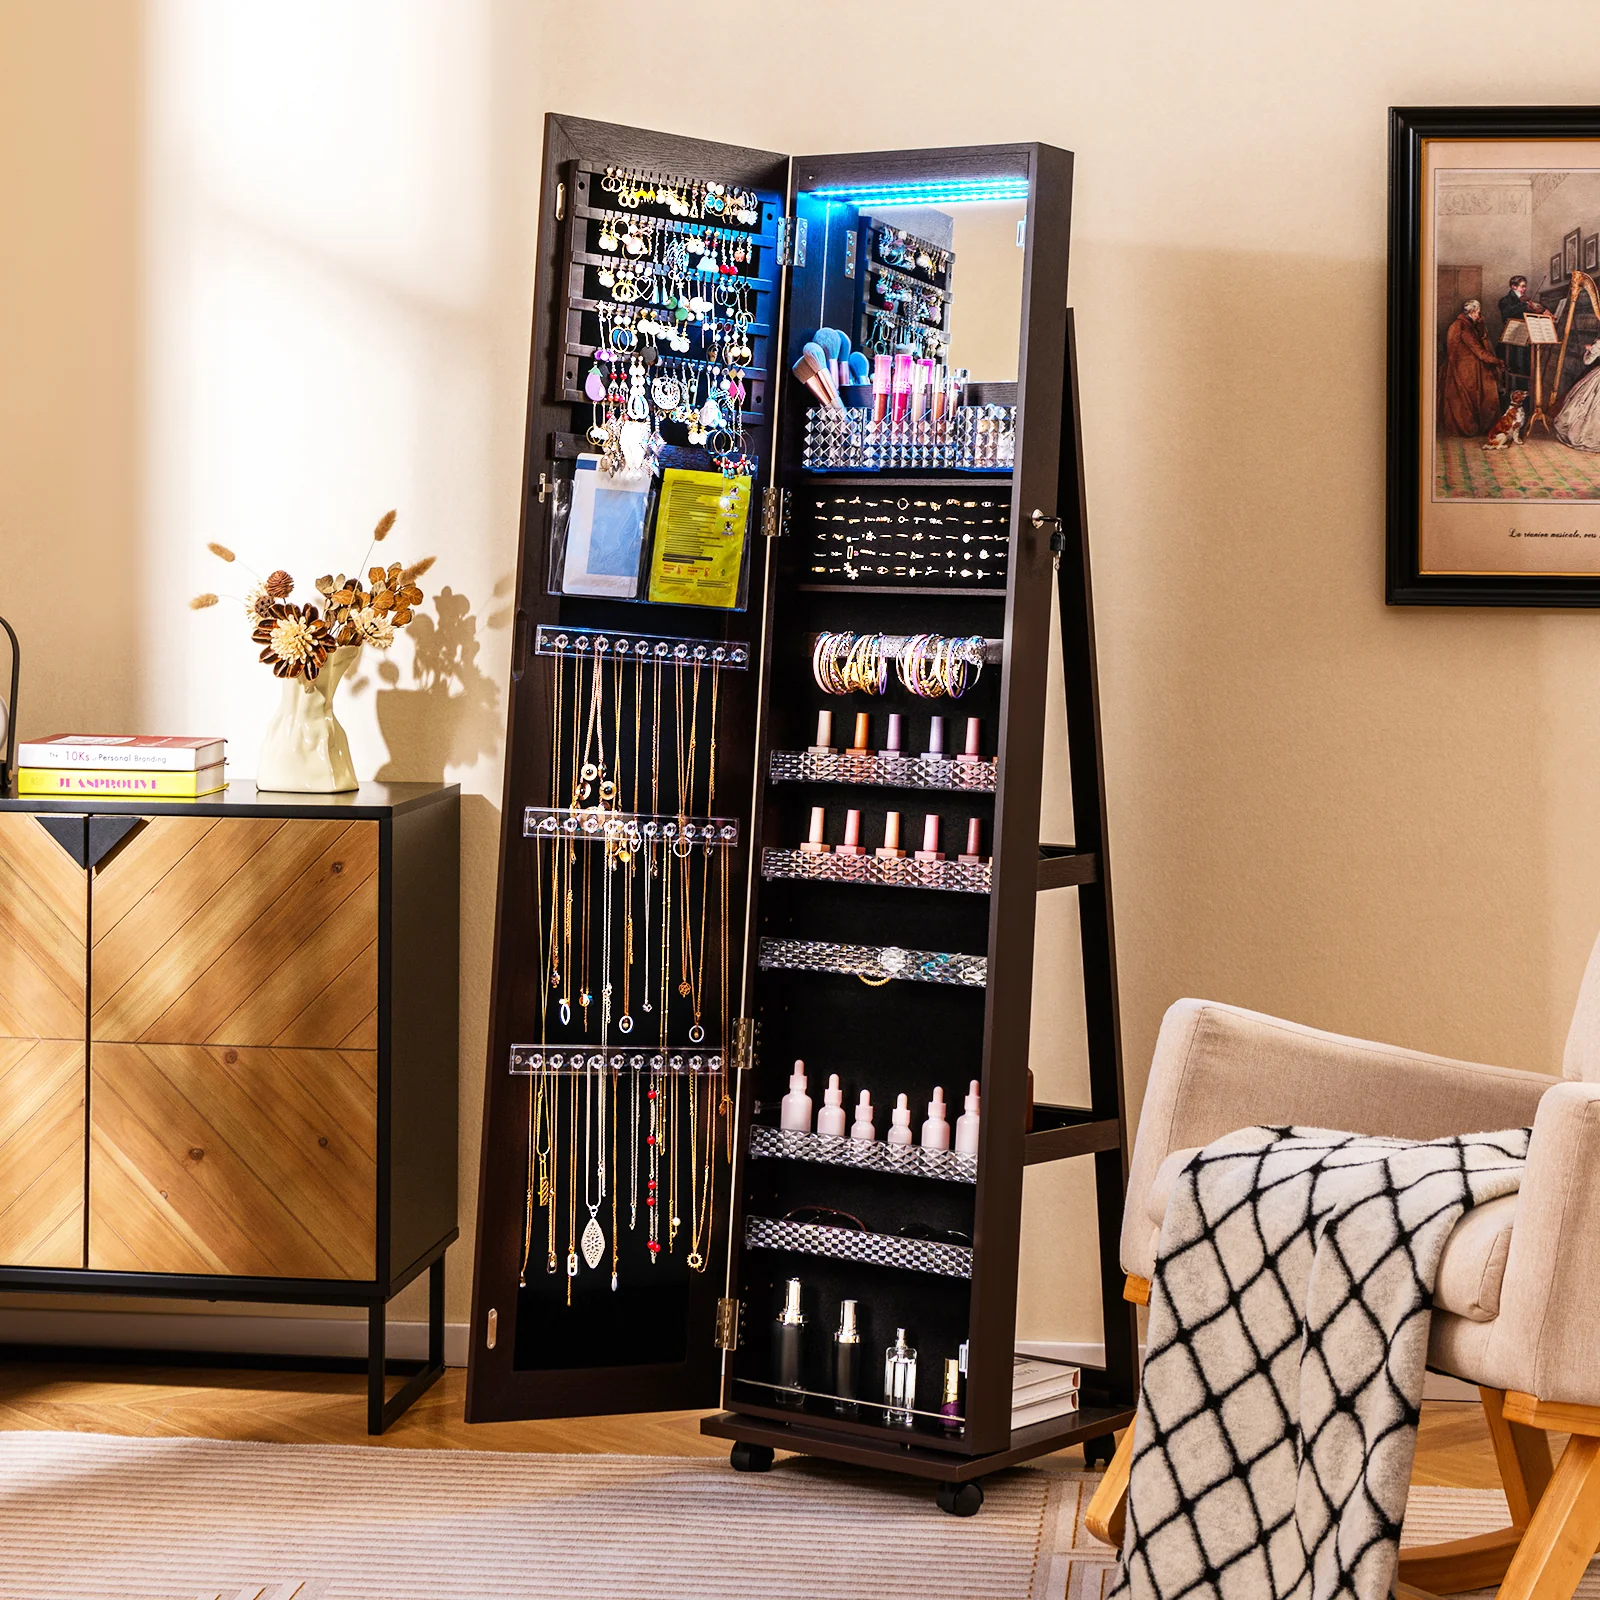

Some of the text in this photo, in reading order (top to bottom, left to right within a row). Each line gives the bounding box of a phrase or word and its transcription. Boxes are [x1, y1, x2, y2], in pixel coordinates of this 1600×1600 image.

[1550, 530, 1581, 539] musicale,
[66, 750, 90, 762] 10Ks
[98, 753, 132, 762] Personal
[134, 755, 167, 764] Branding
